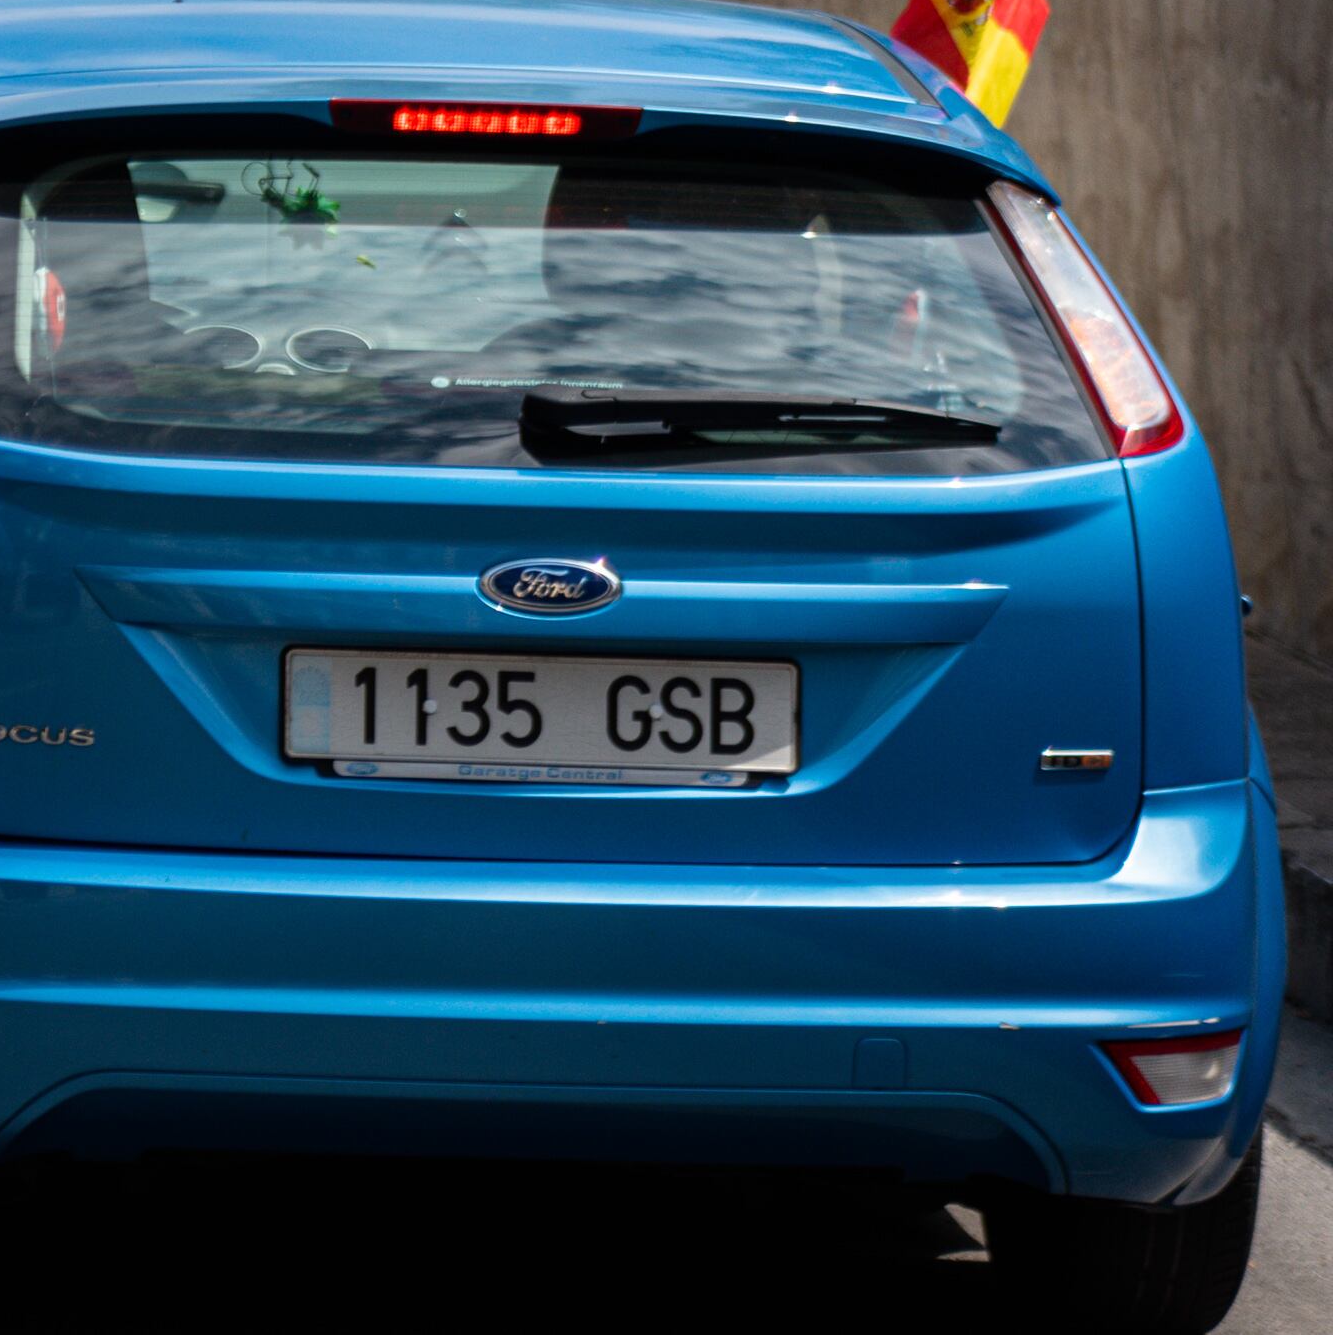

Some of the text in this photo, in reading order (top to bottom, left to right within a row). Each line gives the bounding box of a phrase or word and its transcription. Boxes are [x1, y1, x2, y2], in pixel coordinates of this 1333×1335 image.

[513, 567, 588, 600] Ford
[354, 666, 755, 756] 1135 GSB
[546, 766, 623, 781] Central
